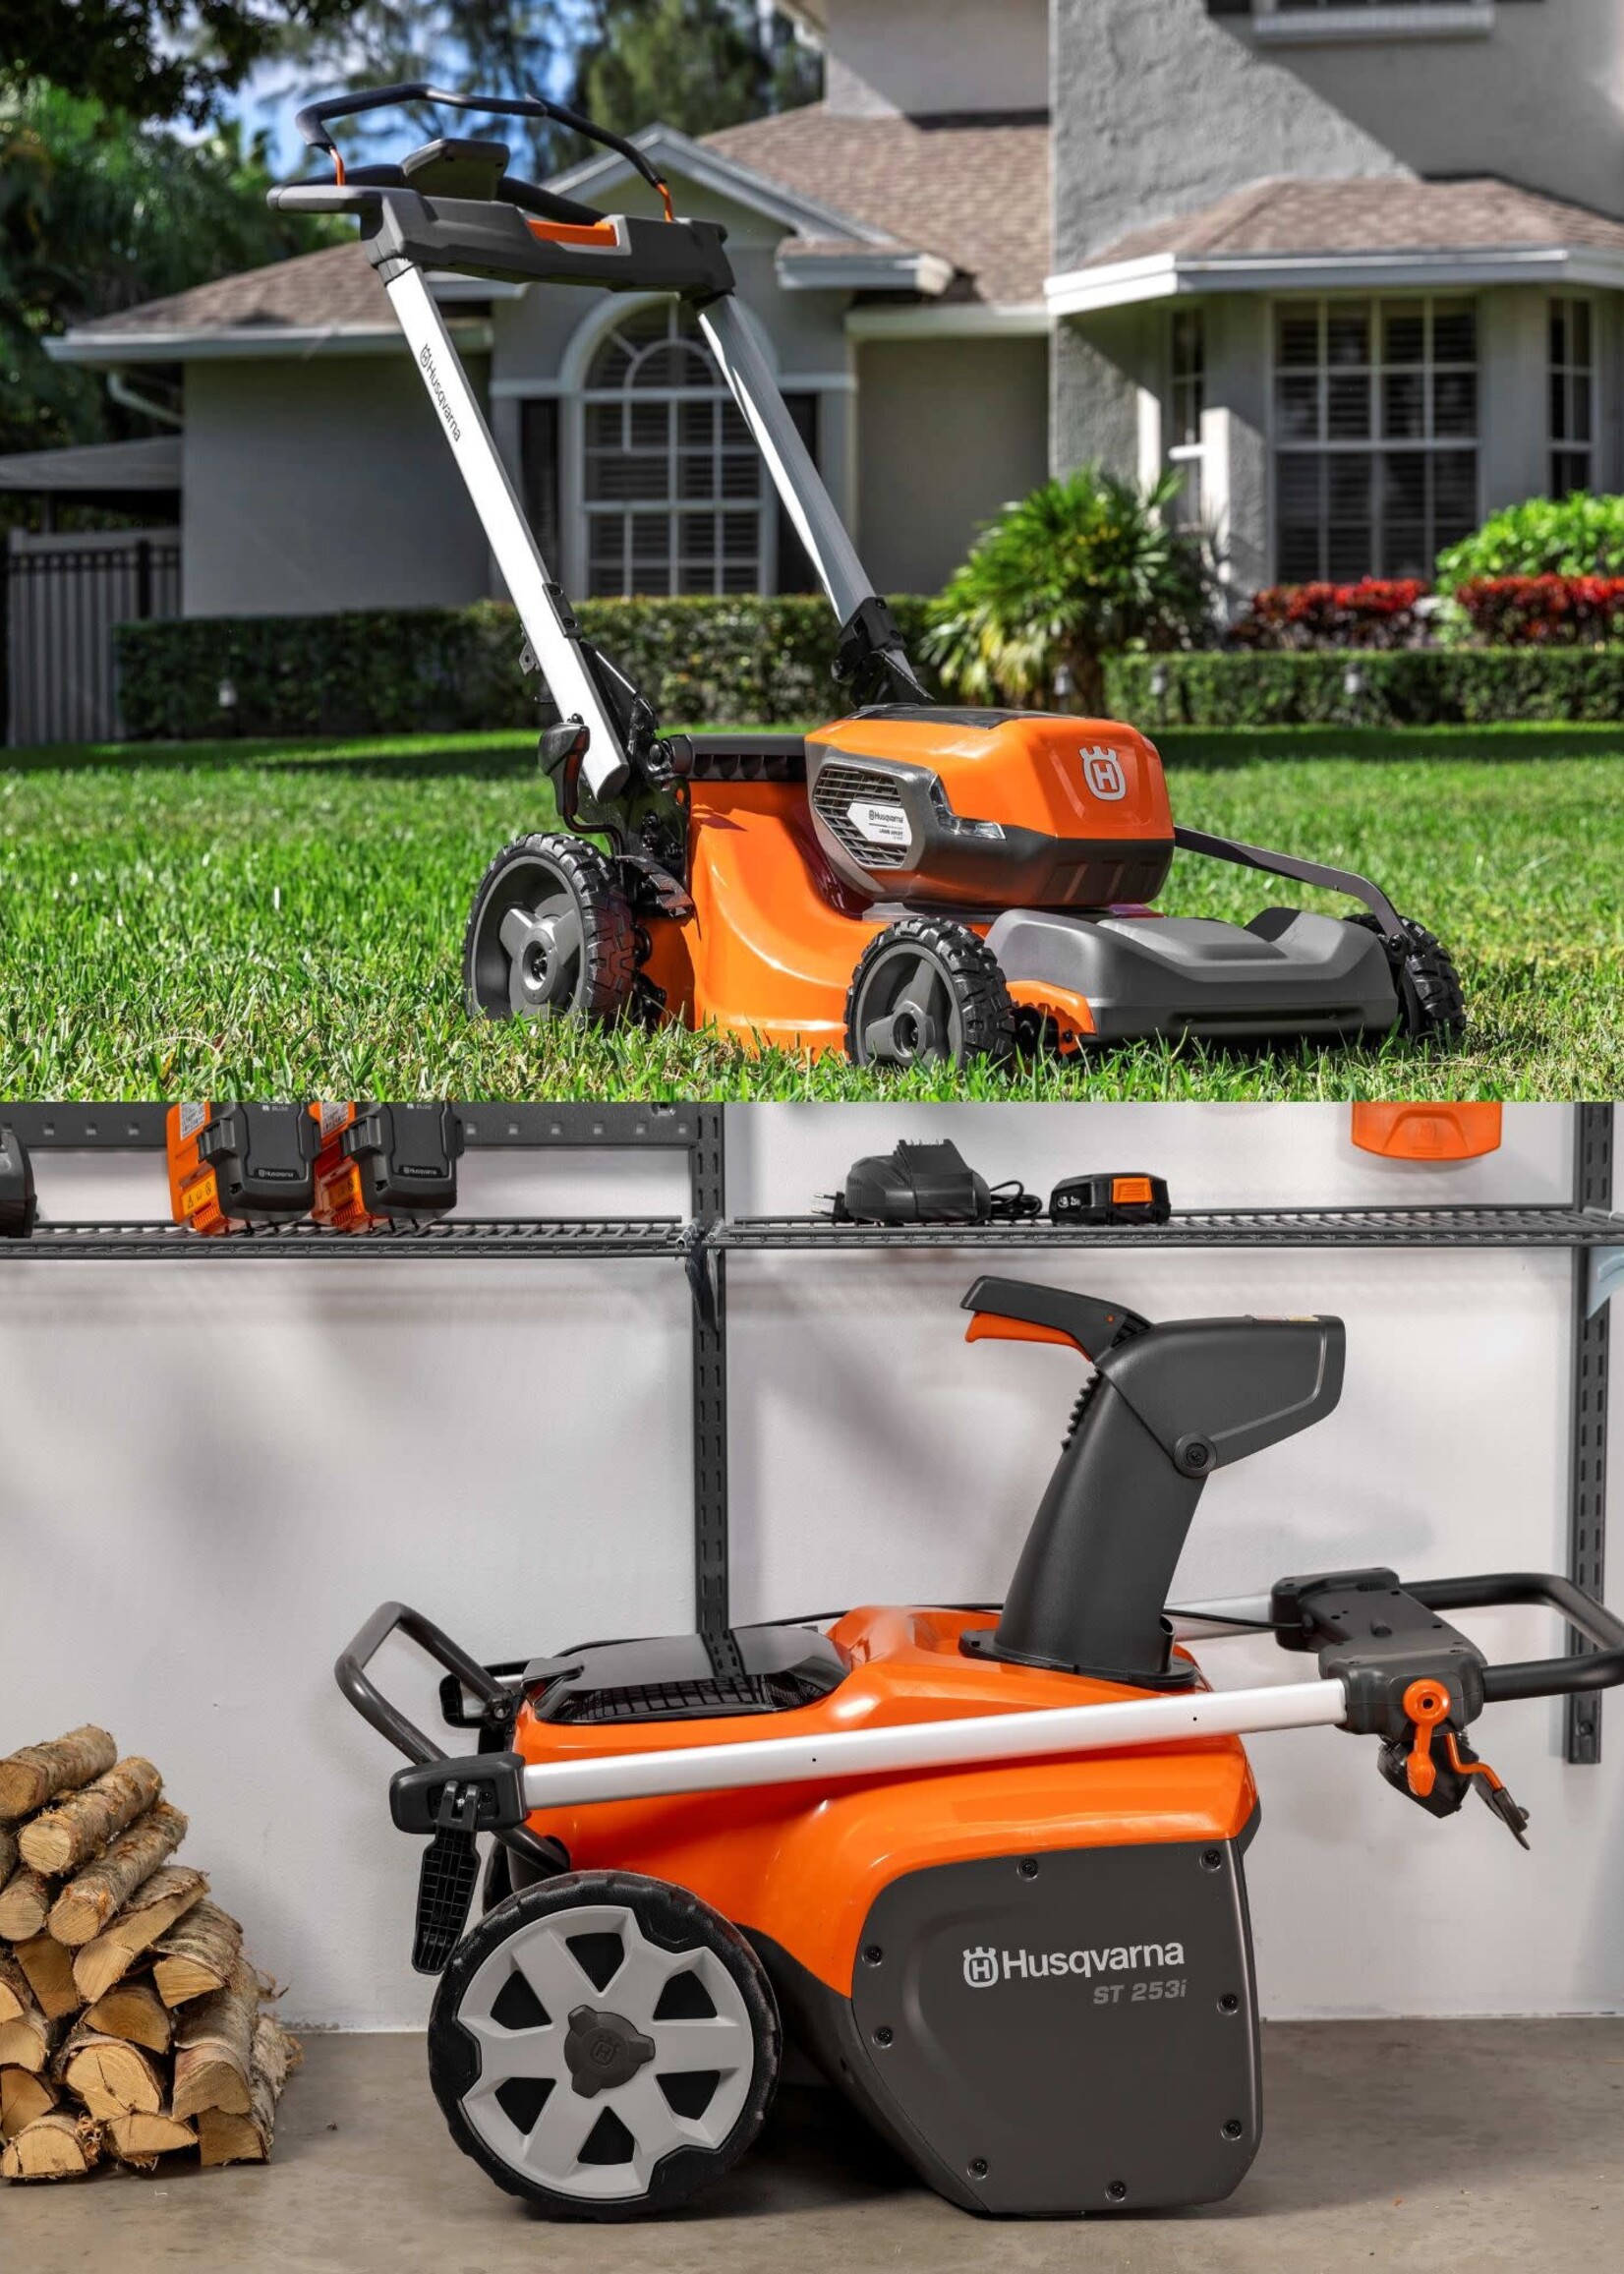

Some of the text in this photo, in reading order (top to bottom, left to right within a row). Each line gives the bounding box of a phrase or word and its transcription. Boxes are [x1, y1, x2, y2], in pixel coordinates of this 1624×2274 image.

[427, 360, 461, 442] Husqvarna
[1002, 1943, 1186, 1980] Husqvarna
[1092, 1979, 1188, 2005] ST 253i
